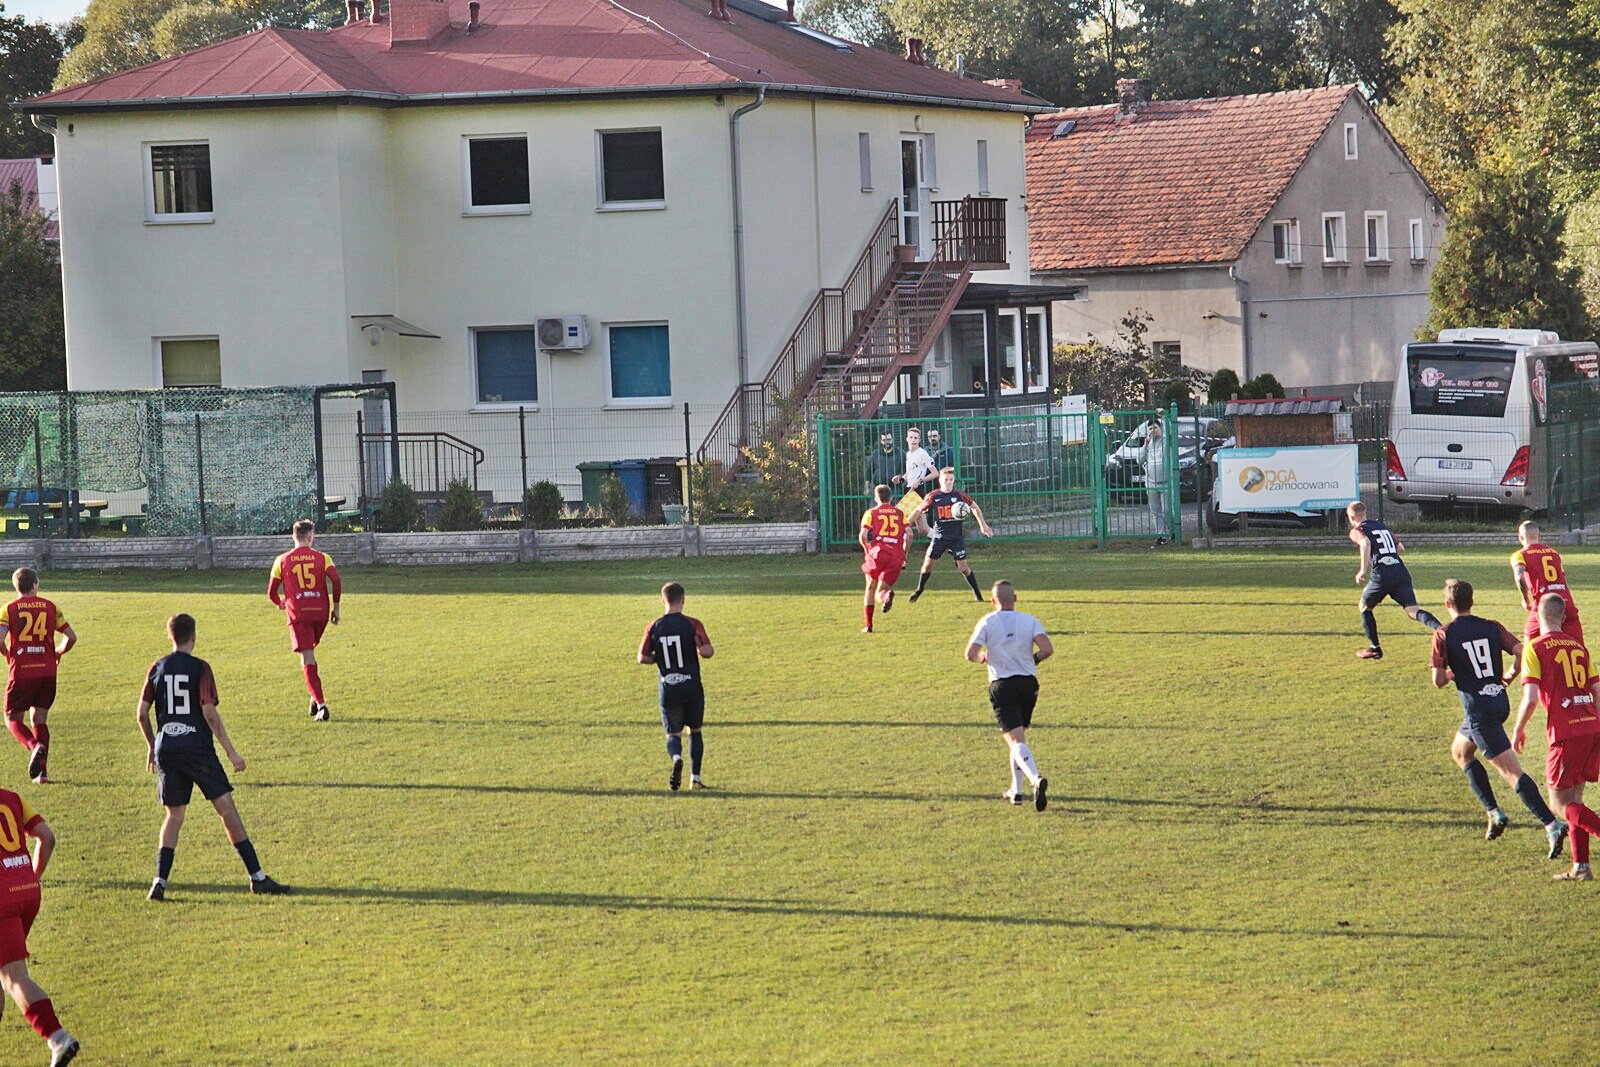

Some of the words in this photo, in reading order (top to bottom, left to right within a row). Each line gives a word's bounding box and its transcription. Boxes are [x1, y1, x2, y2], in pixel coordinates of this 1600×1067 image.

[1265, 469, 1297, 489] PGA
[1269, 481, 1339, 491] zamocowania
[878, 514, 899, 537] 25
[1371, 529, 1397, 554] 30
[291, 562, 316, 589] 15
[1541, 555, 1558, 582] 6
[17, 601, 47, 609] JURASZEK
[18, 611, 48, 642] 24
[659, 635, 684, 669] 17
[1461, 638, 1495, 679] 19
[1554, 648, 1586, 689] 16
[164, 674, 190, 715] 15
